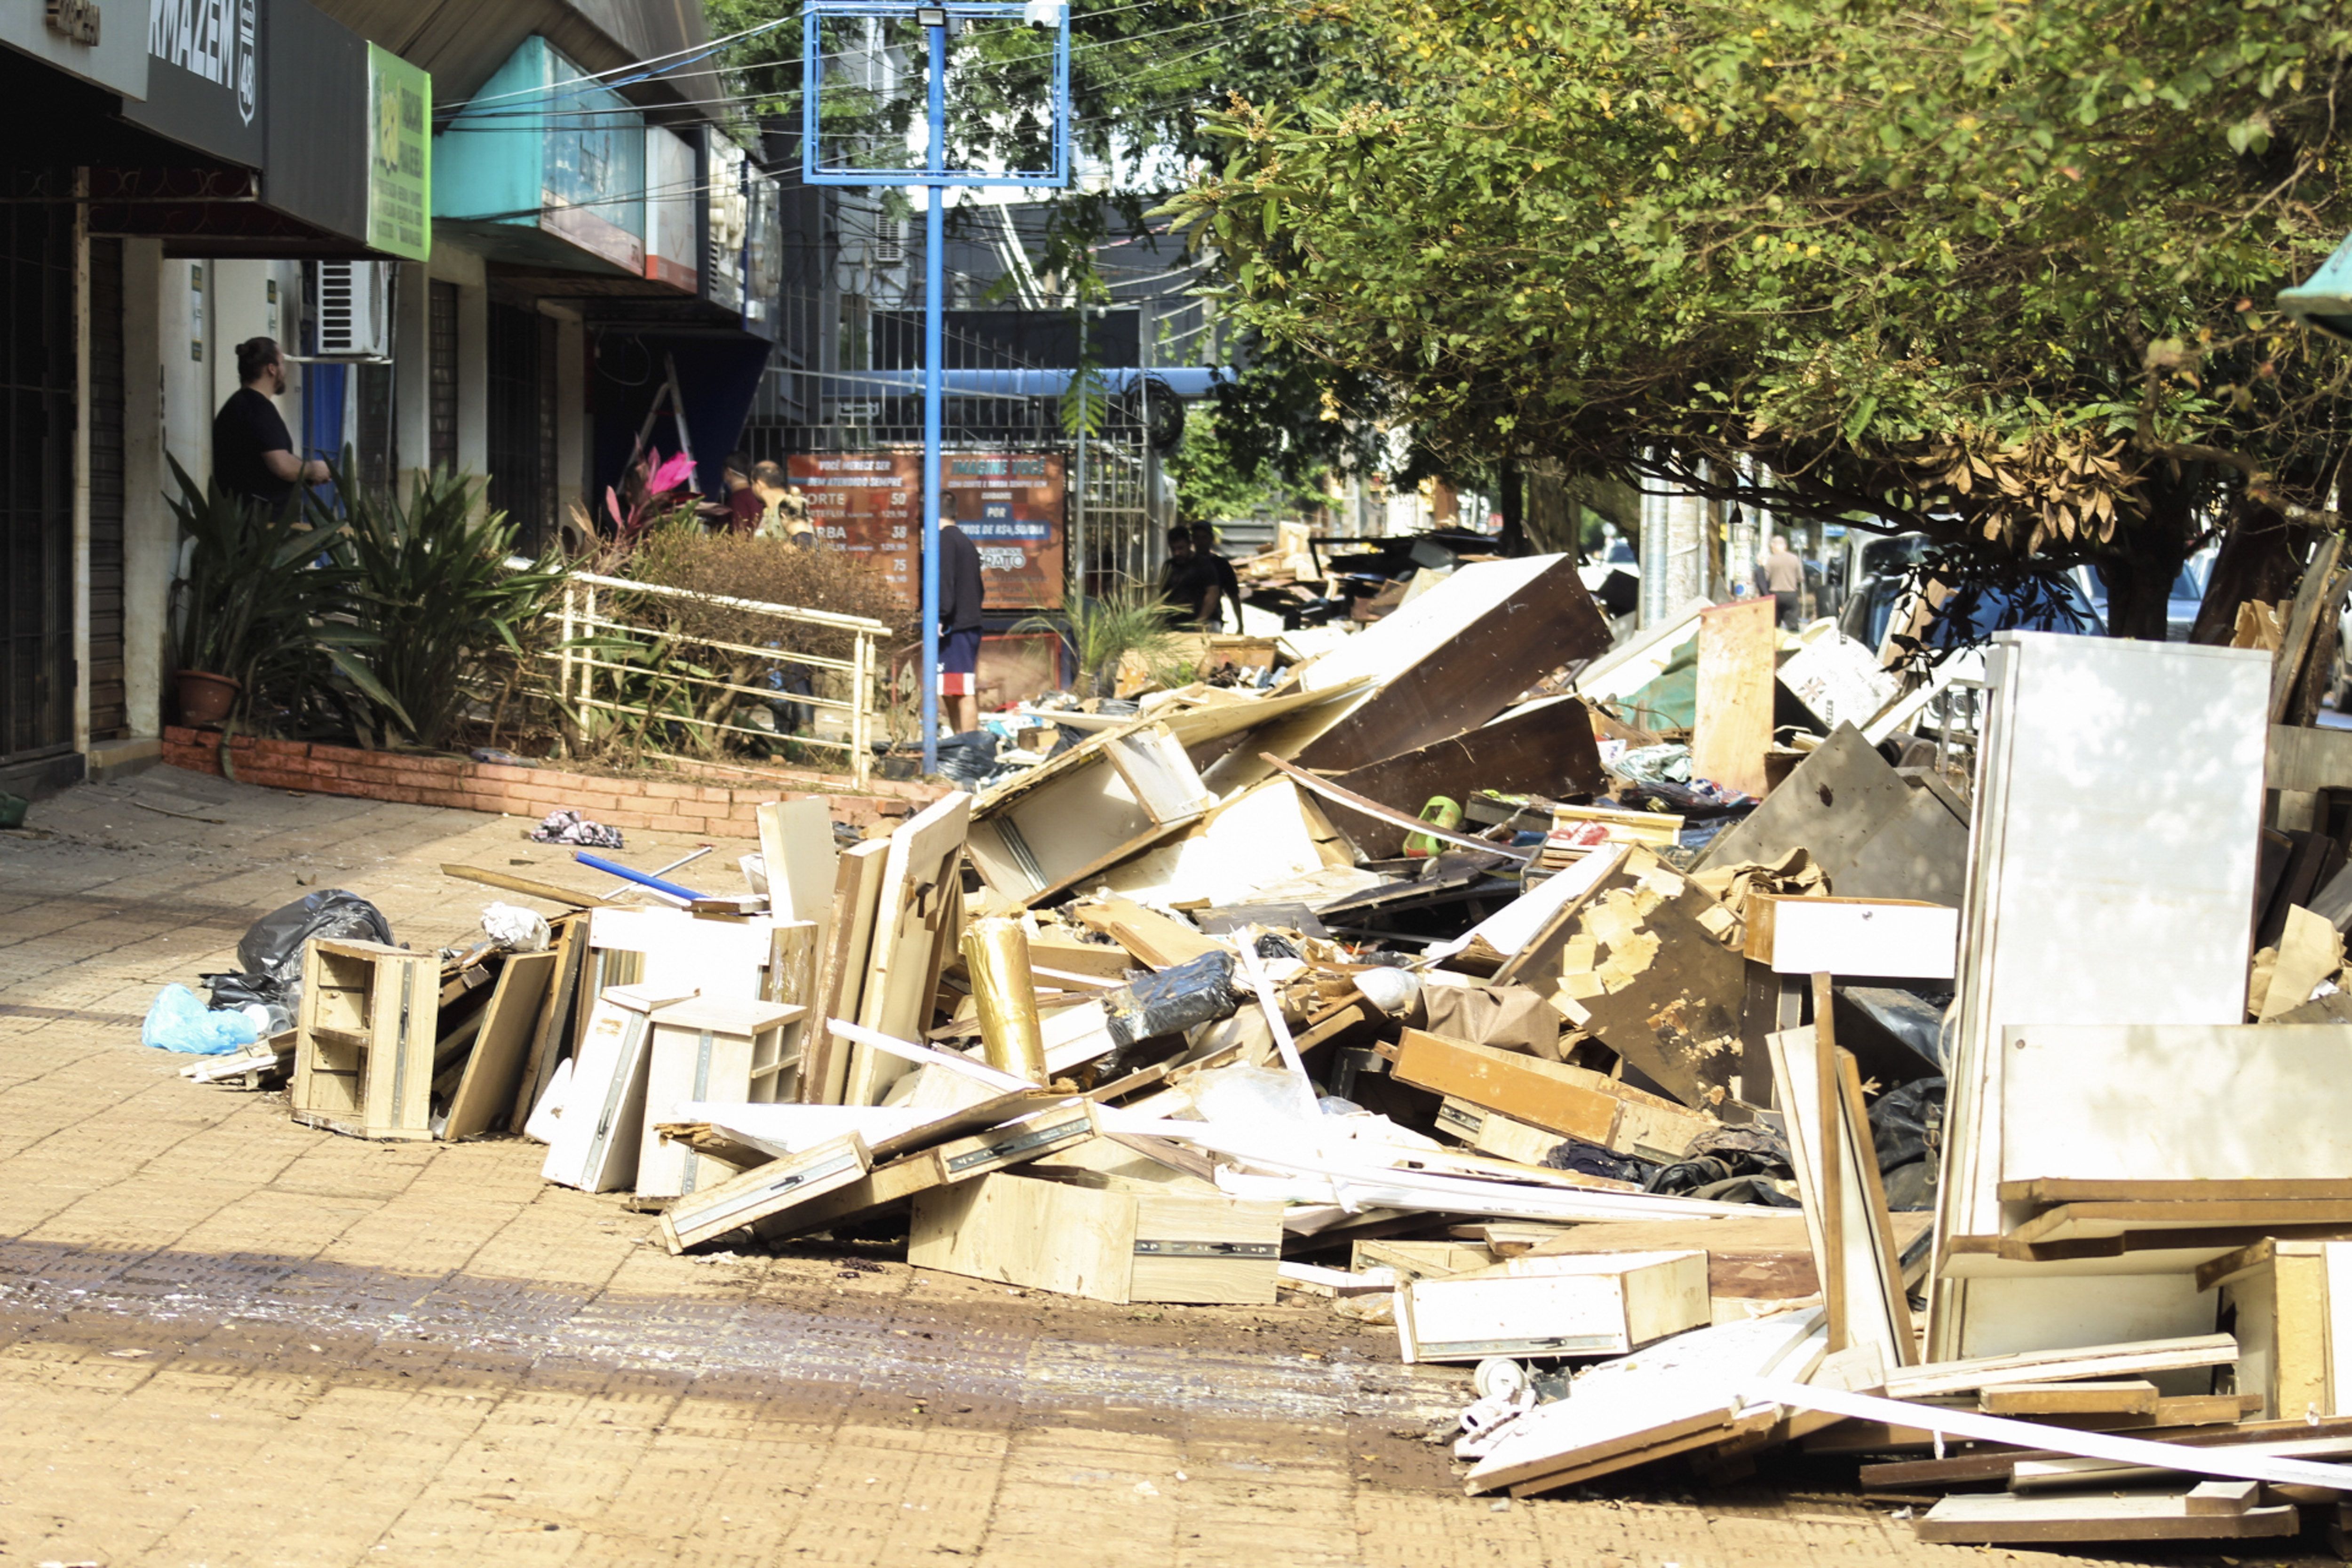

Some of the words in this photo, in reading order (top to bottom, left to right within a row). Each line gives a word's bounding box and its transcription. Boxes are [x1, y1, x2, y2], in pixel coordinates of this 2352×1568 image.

[148, 0, 235, 89] RMAZEM
[241, 53, 252, 105] 48
[819, 459, 841, 470] VOCÊ
[842, 461, 874, 470] MERECE
[875, 461, 890, 470] SER
[951, 459, 1008, 475] IMAGINE
[1012, 456, 1046, 475] VOCÊ
[826, 477, 867, 486] ATENDIDO
[870, 477, 902, 486] SEMPRE
[891, 493, 907, 505] 50
[987, 507, 1006, 517] POR
[817, 526, 846, 538] RBA
[891, 526, 907, 538] 38
[958, 525, 980, 534] ENOS
[982, 525, 993, 534] DE
[893, 559, 907, 572] 75
[981, 554, 1025, 567] RATTO
